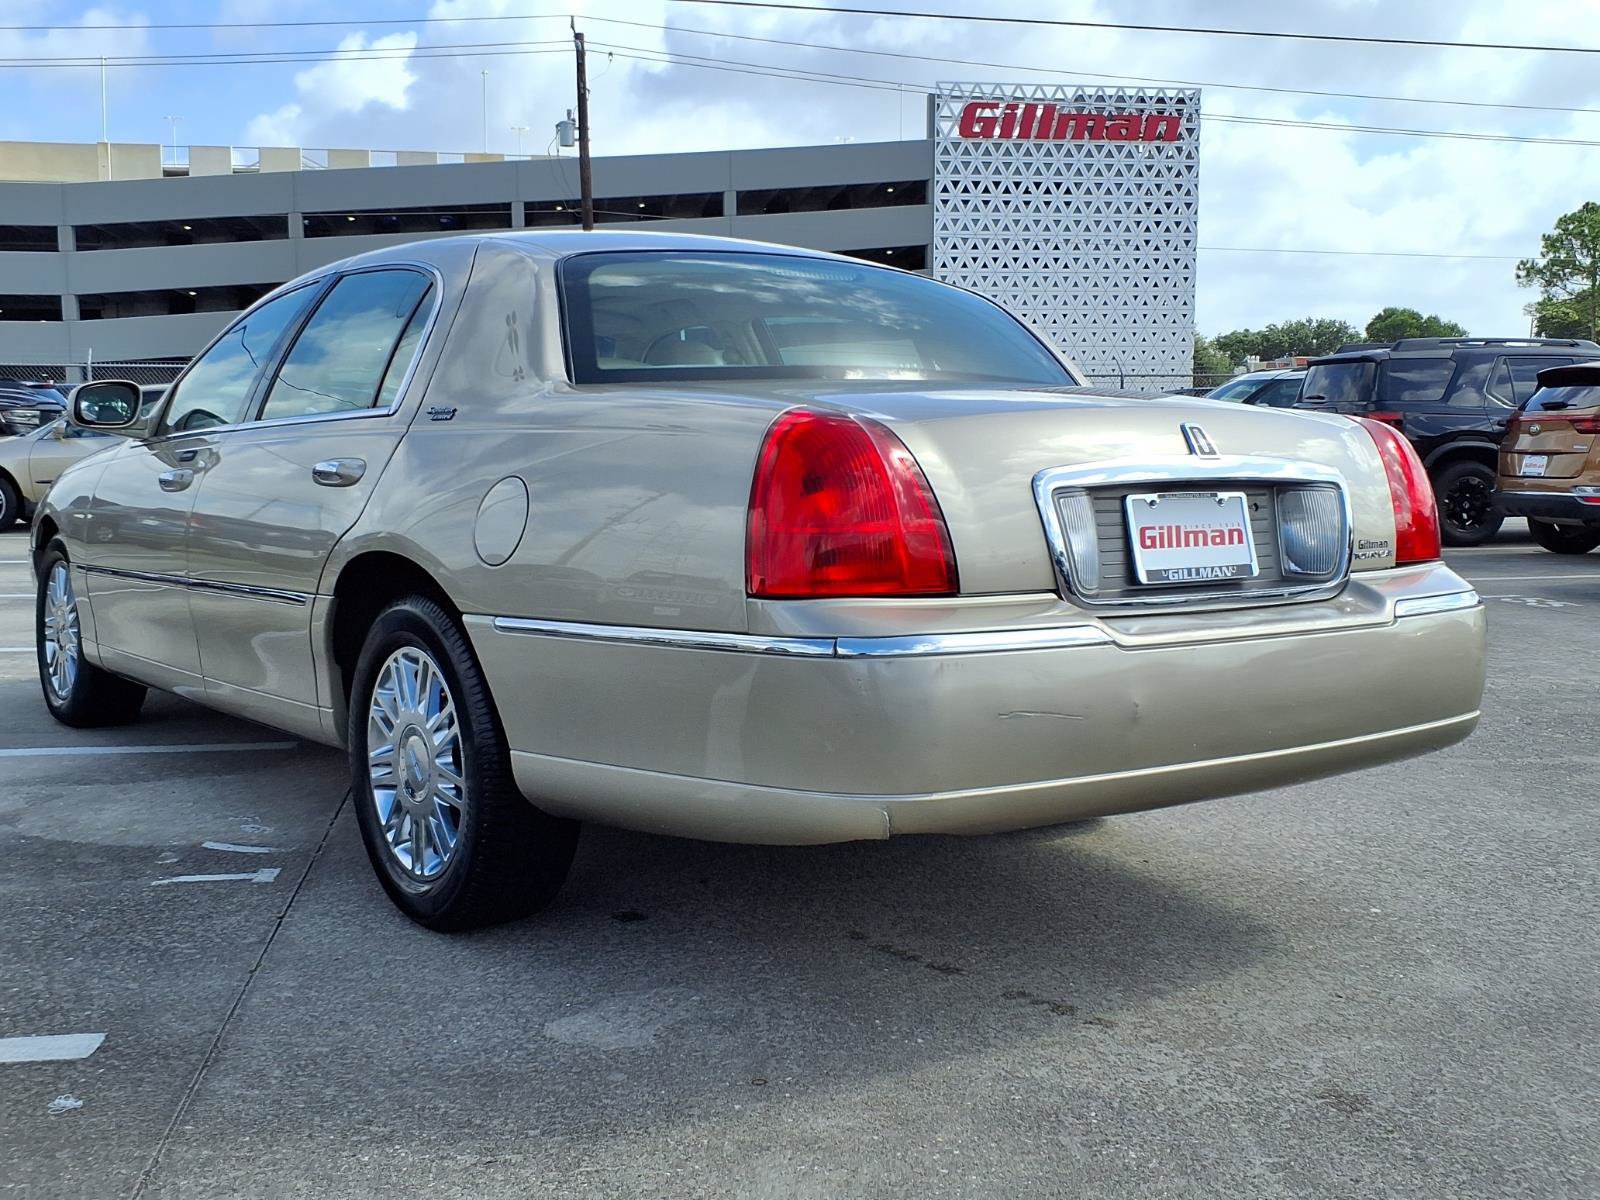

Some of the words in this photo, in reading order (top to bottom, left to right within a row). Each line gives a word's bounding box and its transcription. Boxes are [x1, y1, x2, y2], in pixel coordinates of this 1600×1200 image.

[958, 101, 1182, 141] Gillman
[1139, 525, 1244, 550] Gillman
[1358, 539, 1388, 550] Gillman
[1168, 566, 1232, 580] GILLMAN
